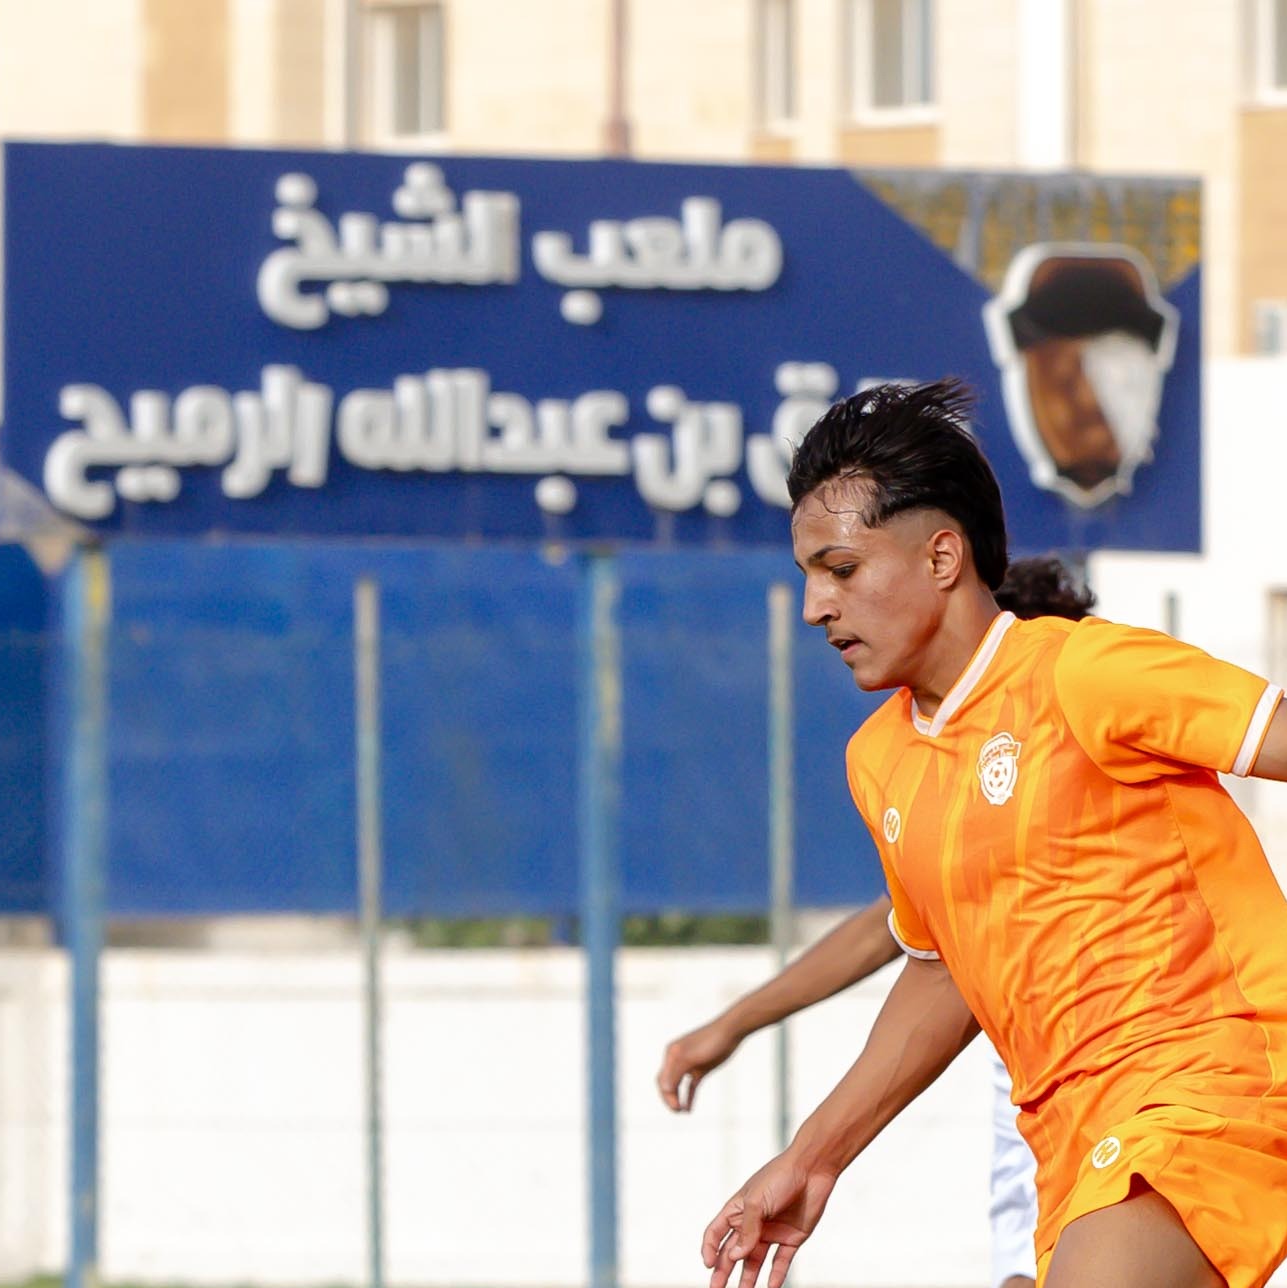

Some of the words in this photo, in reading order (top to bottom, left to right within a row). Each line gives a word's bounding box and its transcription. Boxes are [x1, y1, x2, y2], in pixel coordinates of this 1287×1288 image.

[257, 160, 522, 331] الشيخ
[531, 195, 783, 326] ملعب
[44, 363, 333, 521] الرميح
[336, 366, 631, 516] عبدالله
[631, 383, 743, 517] بن
